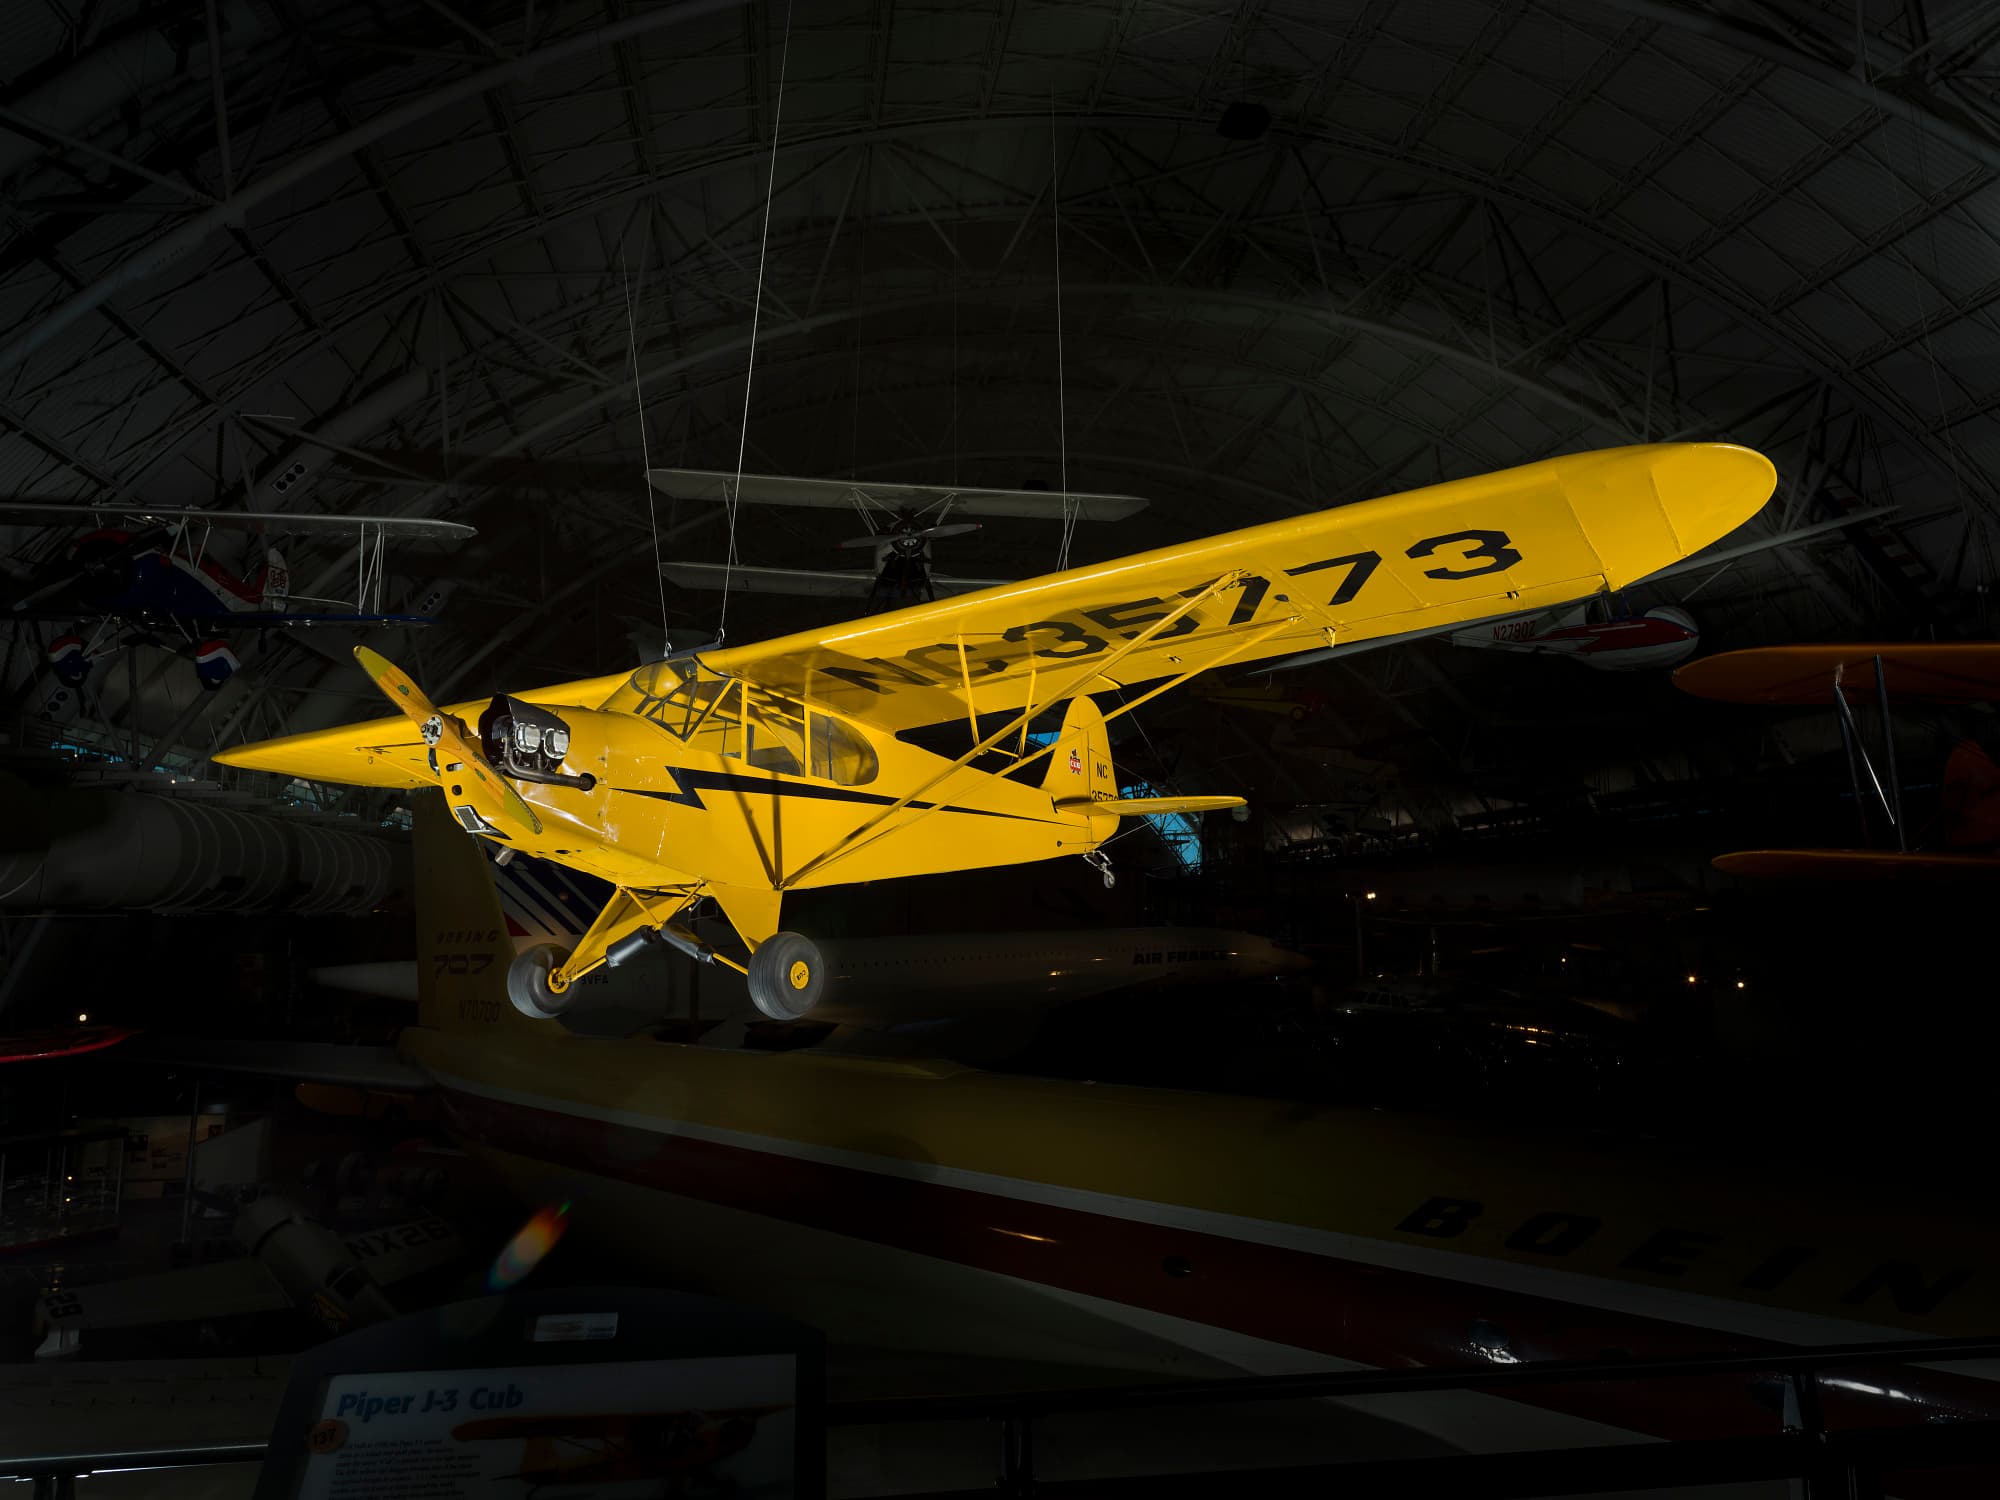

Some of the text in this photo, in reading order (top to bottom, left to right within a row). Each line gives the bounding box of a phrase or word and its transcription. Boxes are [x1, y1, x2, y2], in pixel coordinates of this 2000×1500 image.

[1096, 761, 1108, 779] NC
[432, 953, 496, 979] 707
[1133, 952, 1162, 965] AIR
[1393, 1195, 1974, 1316] BOEIN
[336, 1384, 524, 1423] Piper J-3 Cub
[312, 1428, 337, 1446] 137
